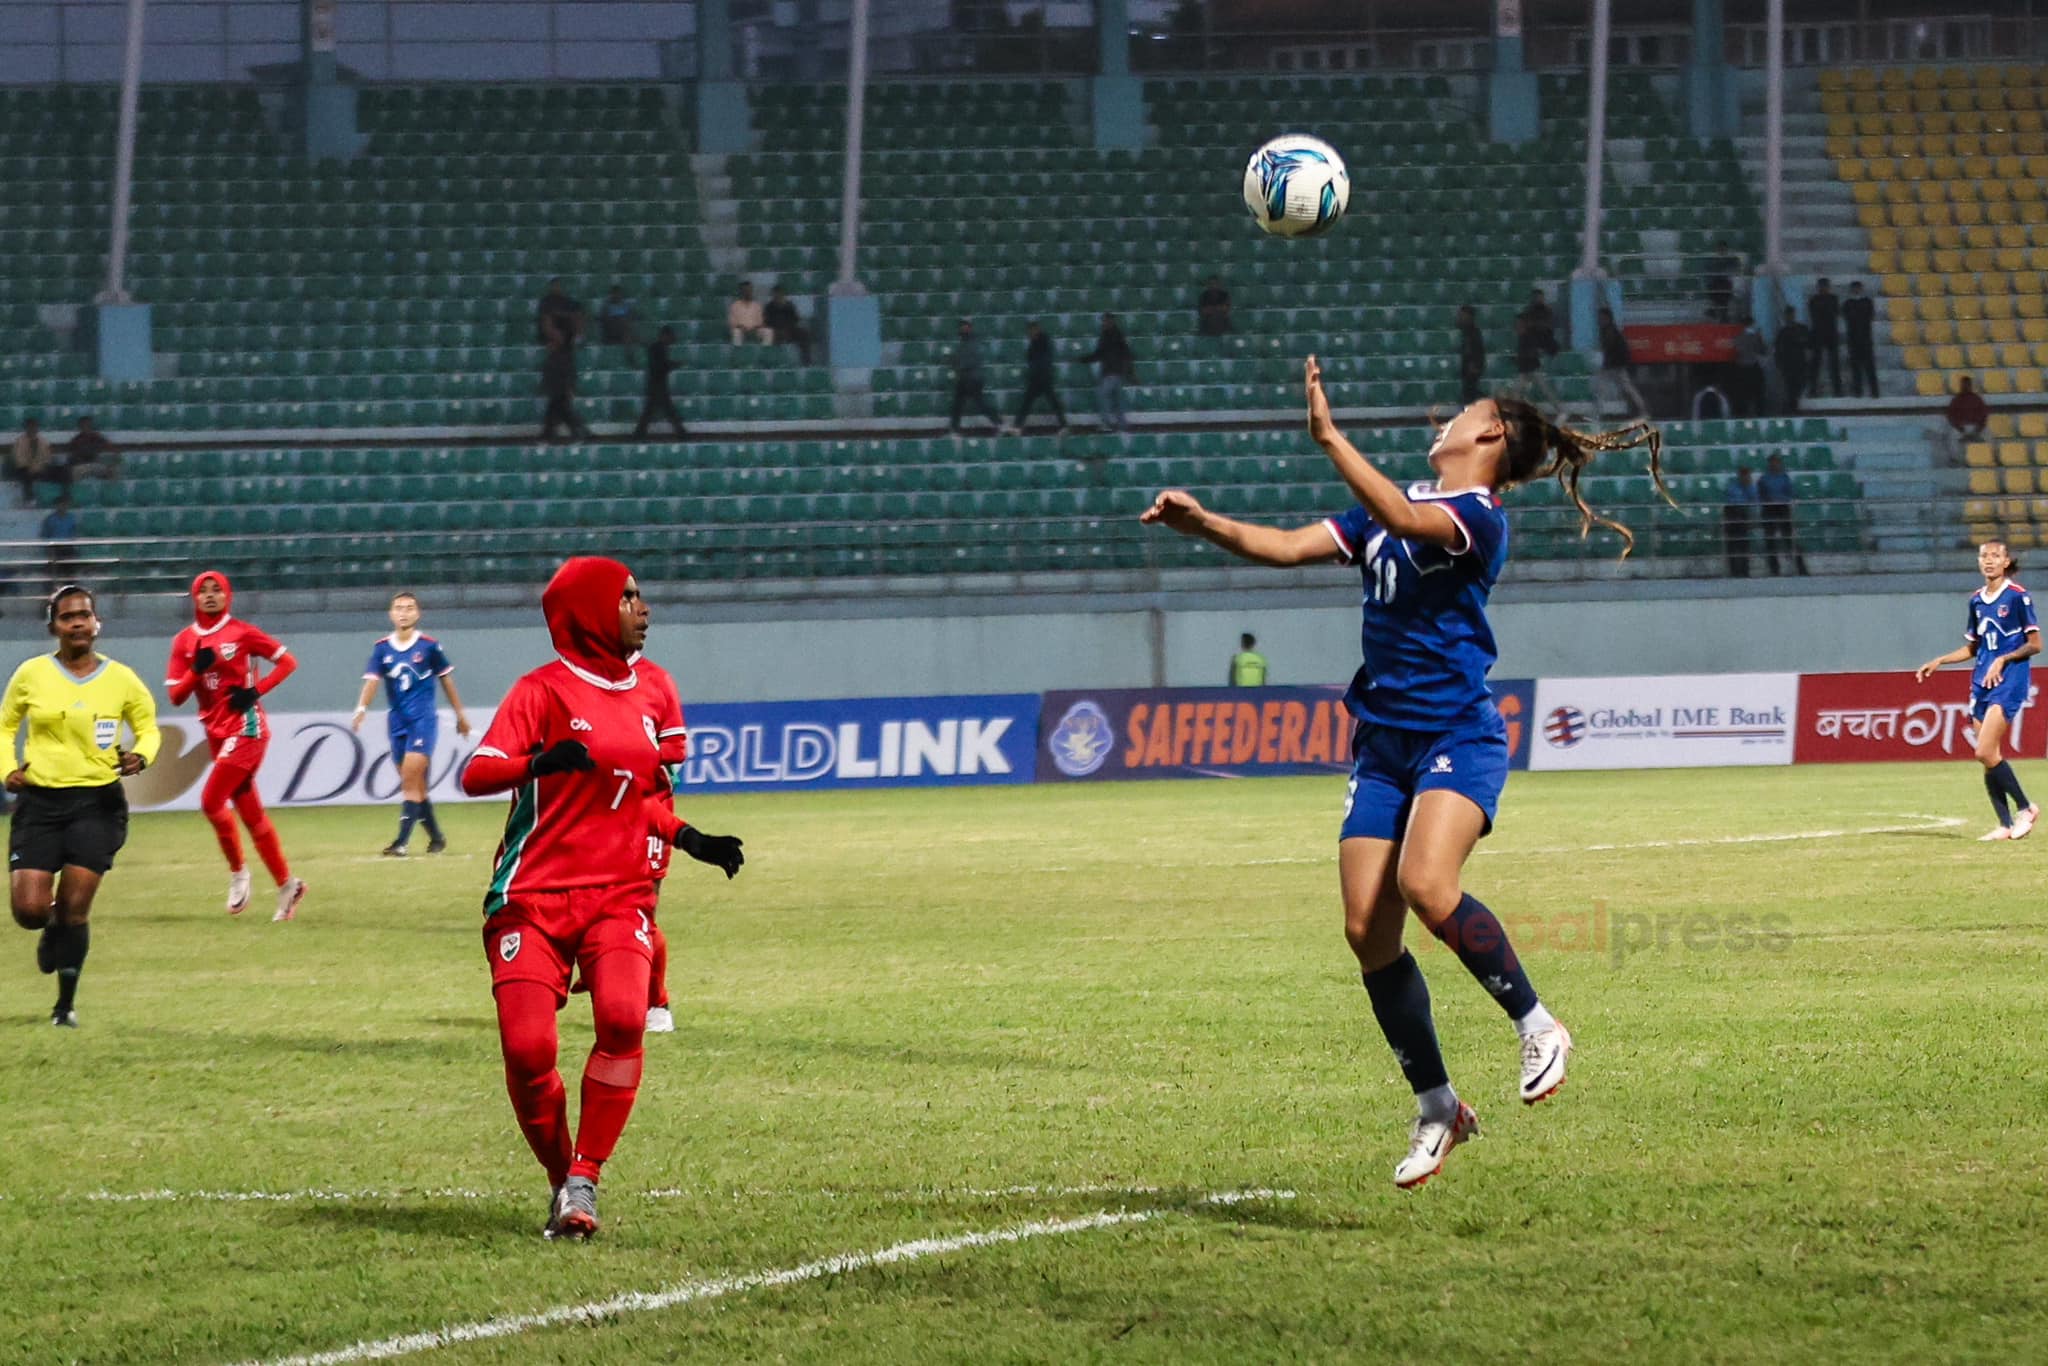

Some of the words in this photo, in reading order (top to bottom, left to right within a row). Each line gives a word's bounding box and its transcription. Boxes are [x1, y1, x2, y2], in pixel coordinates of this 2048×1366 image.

[1371, 557, 1398, 604] 18
[1984, 631, 1998, 651] 12
[1589, 708, 1661, 729] Global
[1671, 708, 1719, 727] IME
[1729, 706, 1786, 726] Bank
[1815, 710, 1901, 741] बचत
[685, 718, 1013, 785] RLDLINK
[610, 768, 633, 810] 7
[646, 835, 663, 860] 14
